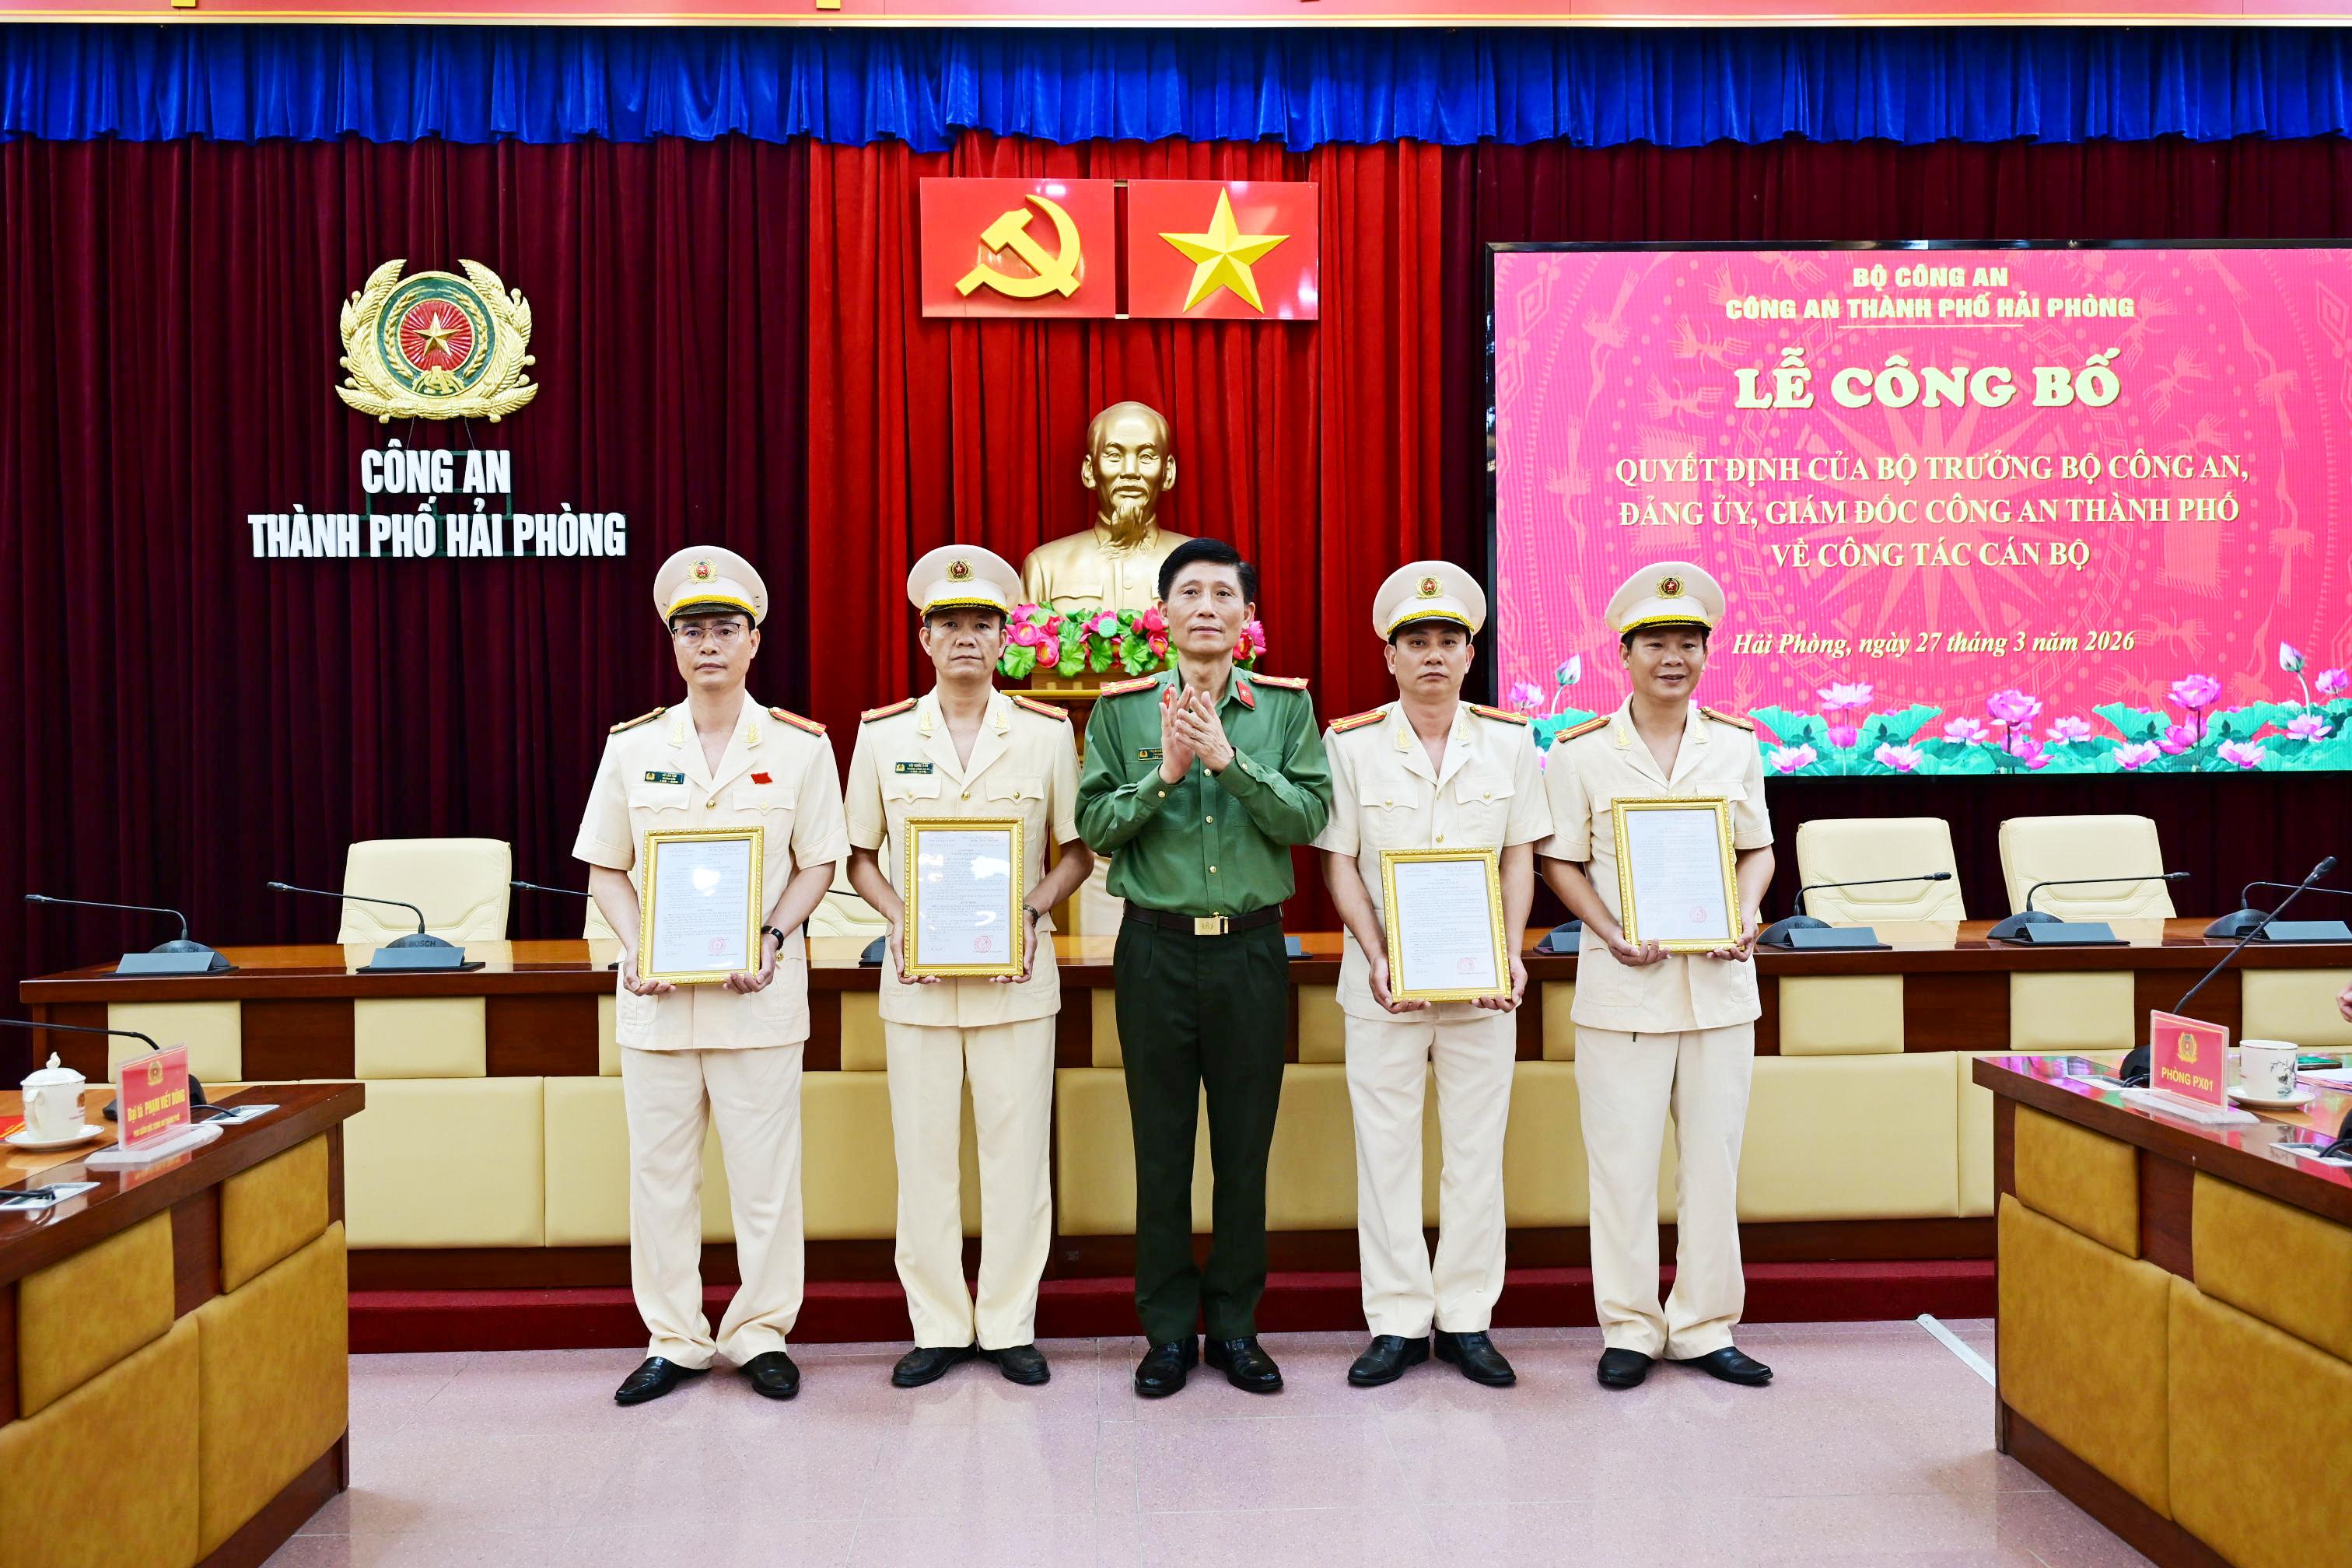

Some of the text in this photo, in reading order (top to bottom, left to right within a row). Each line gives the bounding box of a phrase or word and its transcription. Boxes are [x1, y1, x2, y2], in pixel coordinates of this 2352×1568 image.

[1853, 263, 2008, 292] BỘ CÔNG AN
[1725, 290, 2134, 320] CÔNG AN THÀNH PHỐ HẢI PHÒNG
[1734, 347, 2121, 409] LỄ CÔNG BỐ
[361, 438, 511, 494] CÔNG AN
[1615, 448, 2249, 488] QUYẾT ĐỊNH CỦA BỘ TRƯỞNG BỘ CÔNG AN,
[247, 496, 626, 558] THÀNH PHỐ HẢI PHÒNG
[1619, 491, 2239, 530] ĐẢNG ỦY, GIÁM ĐỐC CÔNG AN THÀNH PHỐ
[1770, 536, 2090, 571] VỀ CÔNG TÁC CÁN BỘ
[1731, 630, 2136, 659] Hải Phòng, ngày 27 tháng 3 năm 2026
[2161, 1066, 2214, 1092] PHÒNG PX01
